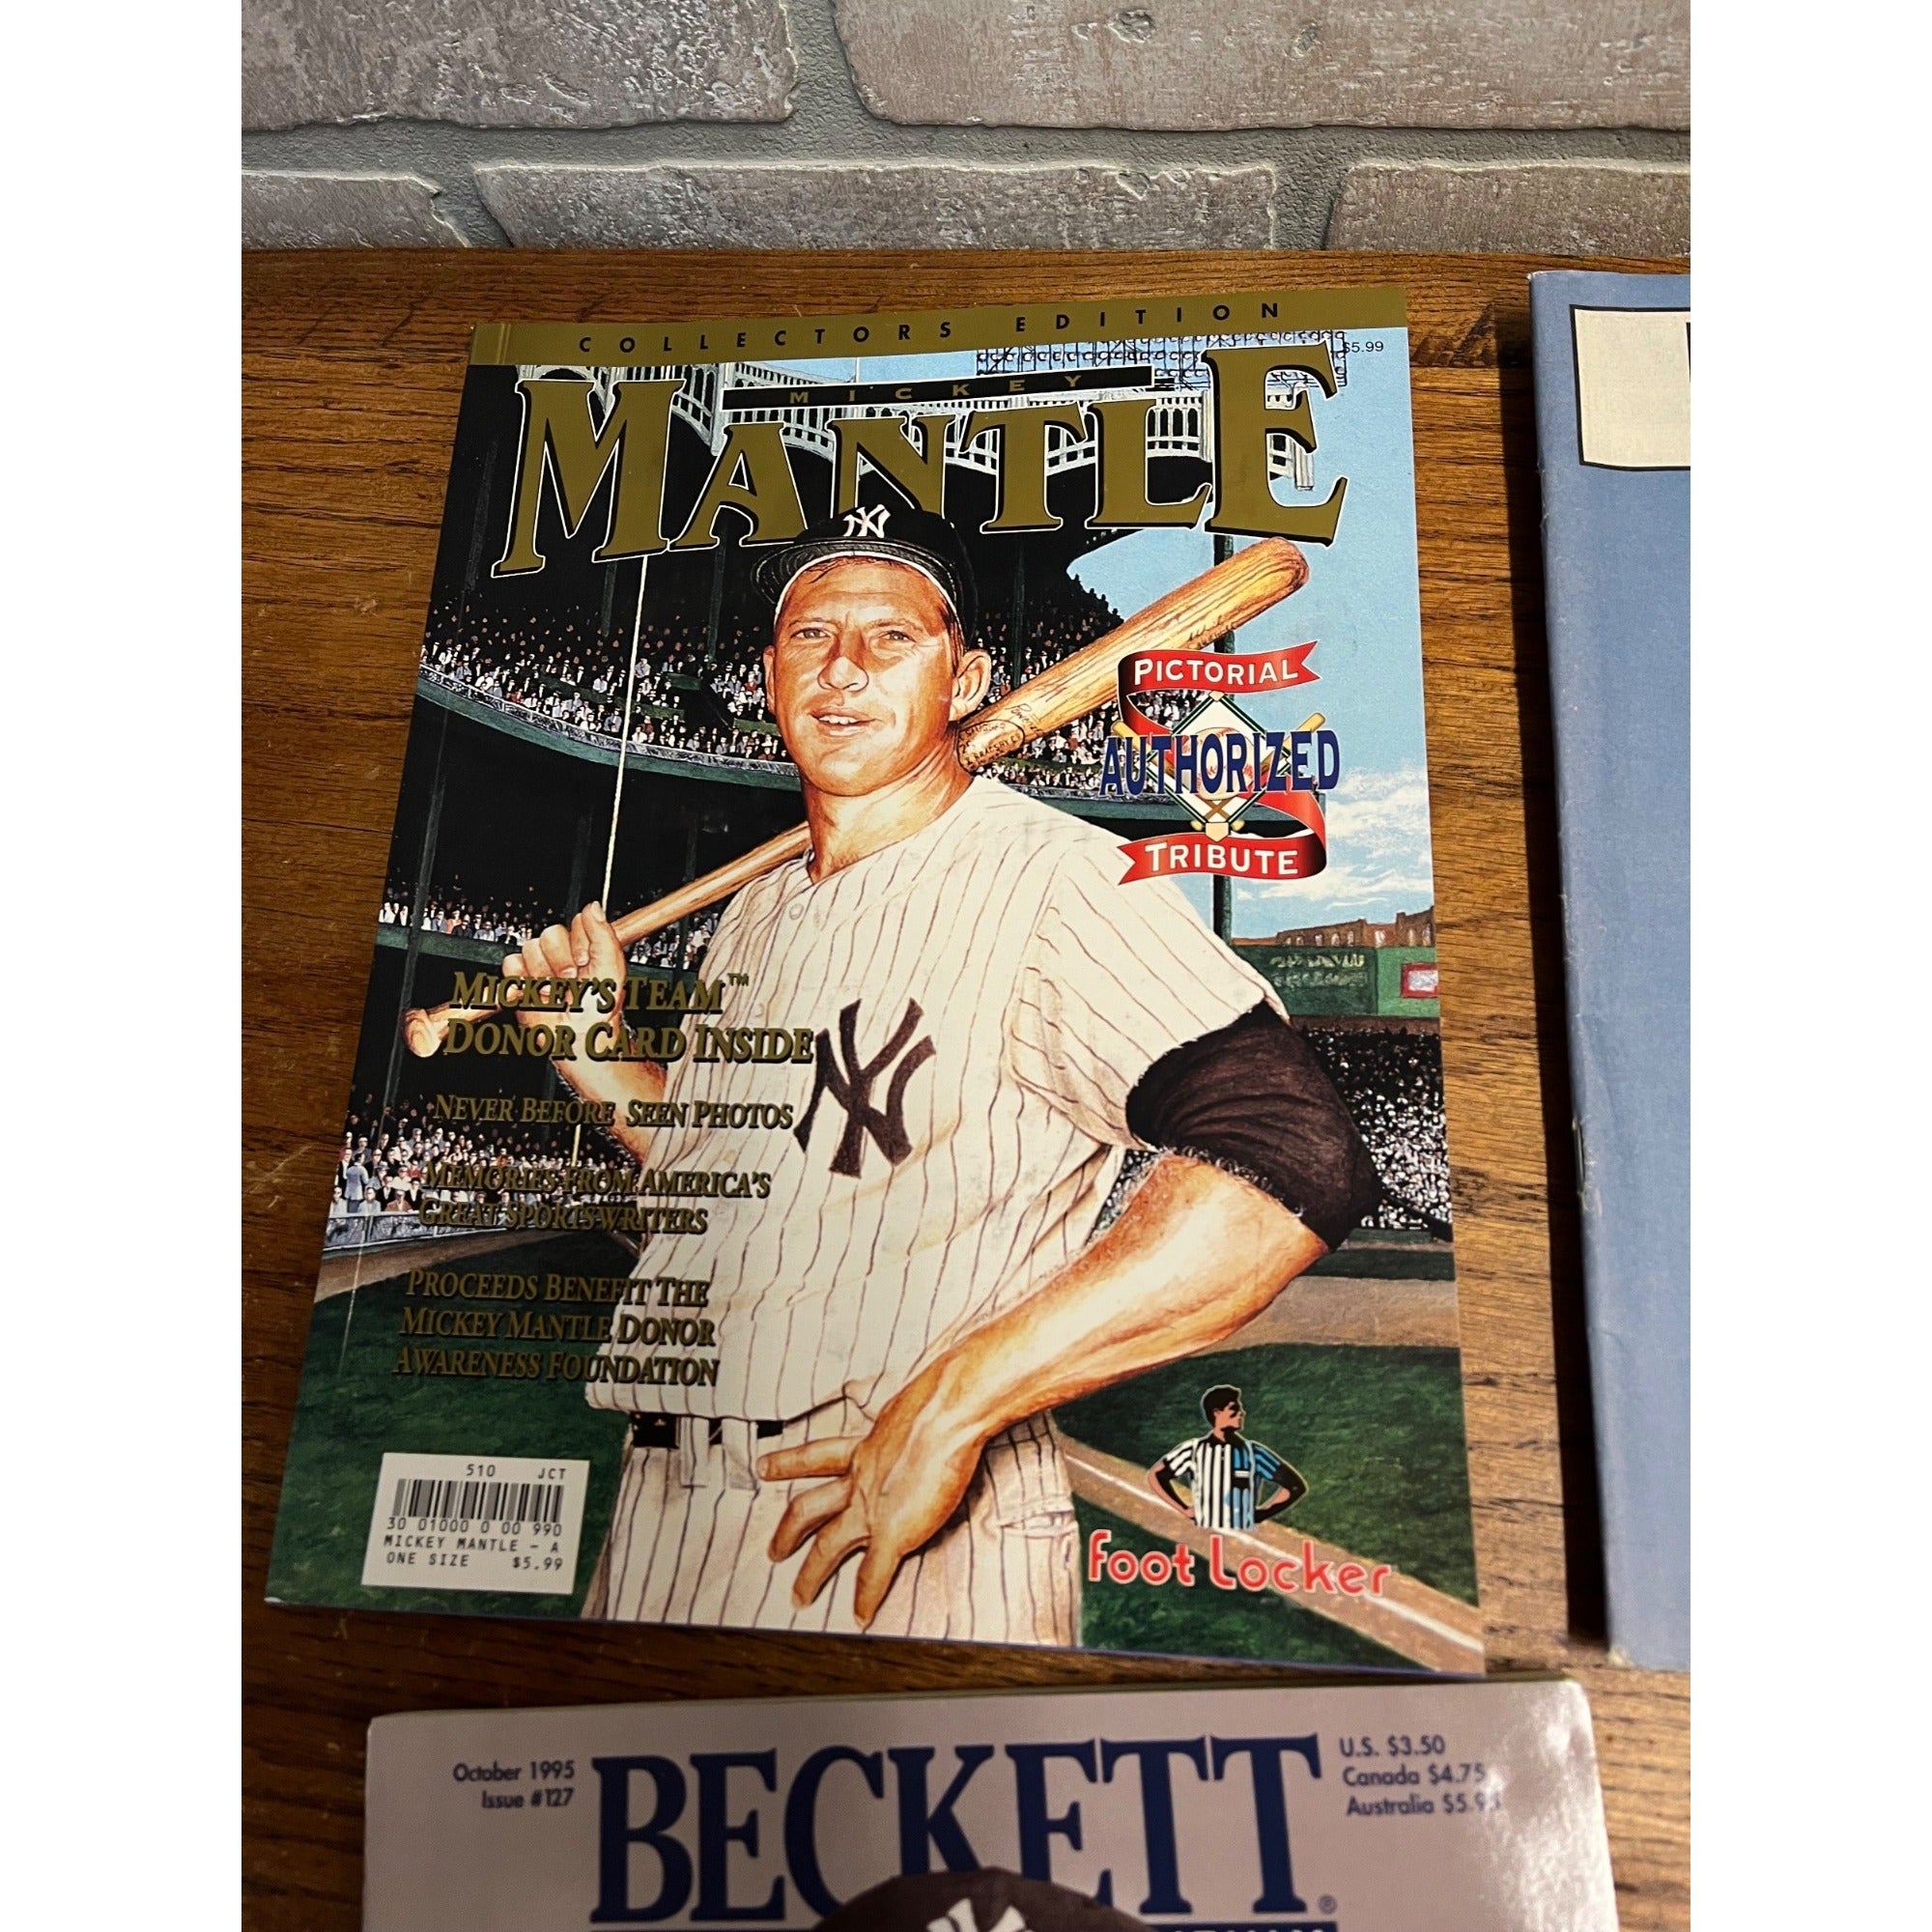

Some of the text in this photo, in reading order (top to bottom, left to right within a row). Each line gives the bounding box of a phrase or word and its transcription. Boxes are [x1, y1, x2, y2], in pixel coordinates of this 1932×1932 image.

[580, 301, 1279, 354] COLLECTORS EDITION
[1341, 340, 1384, 354] $5.99
[789, 375, 1082, 404] MICKEY
[491, 340, 1350, 578] MANTLE
[1133, 657, 1299, 686] PICTORIAL
[1098, 728, 1341, 797] AUTHORIZED
[1144, 841, 1298, 875] TRIBUTE
[449, 972, 616, 1012] MICKEY'S
[442, 1017, 814, 1064] DONOR CARD INSIDE
[434, 1094, 794, 1130] NEVER BEFORE SEEN PHOTOS
[422, 1161, 772, 1199] MEMORIES FROM AMERICA'S
[418, 1197, 498, 1228] GREAT
[406, 1268, 711, 1307] PROCEEDS BENEFIT THE
[399, 1307, 715, 1347] MICKEY MANTLE DONOR
[393, 1345, 722, 1387] AWARENESS FOUNDATION
[466, 1463, 567, 1480] 510 JCT
[386, 1518, 562, 1537] 30 01000 0 00 990
[384, 1535, 446, 1549] MICKEY
[457, 1537, 519, 1552] MANTLE
[551, 1542, 559, 1553] A
[386, 1551, 563, 1571] ONE SIZE $5.99
[1339, 1734, 1446, 1757] U.S. $3.50
[453, 1759, 576, 1782] October 1995
[1343, 1762, 1487, 1786] Canada $4.75
[482, 1787, 575, 1808] Issue #127
[1347, 1793, 1435, 1816] Australia
